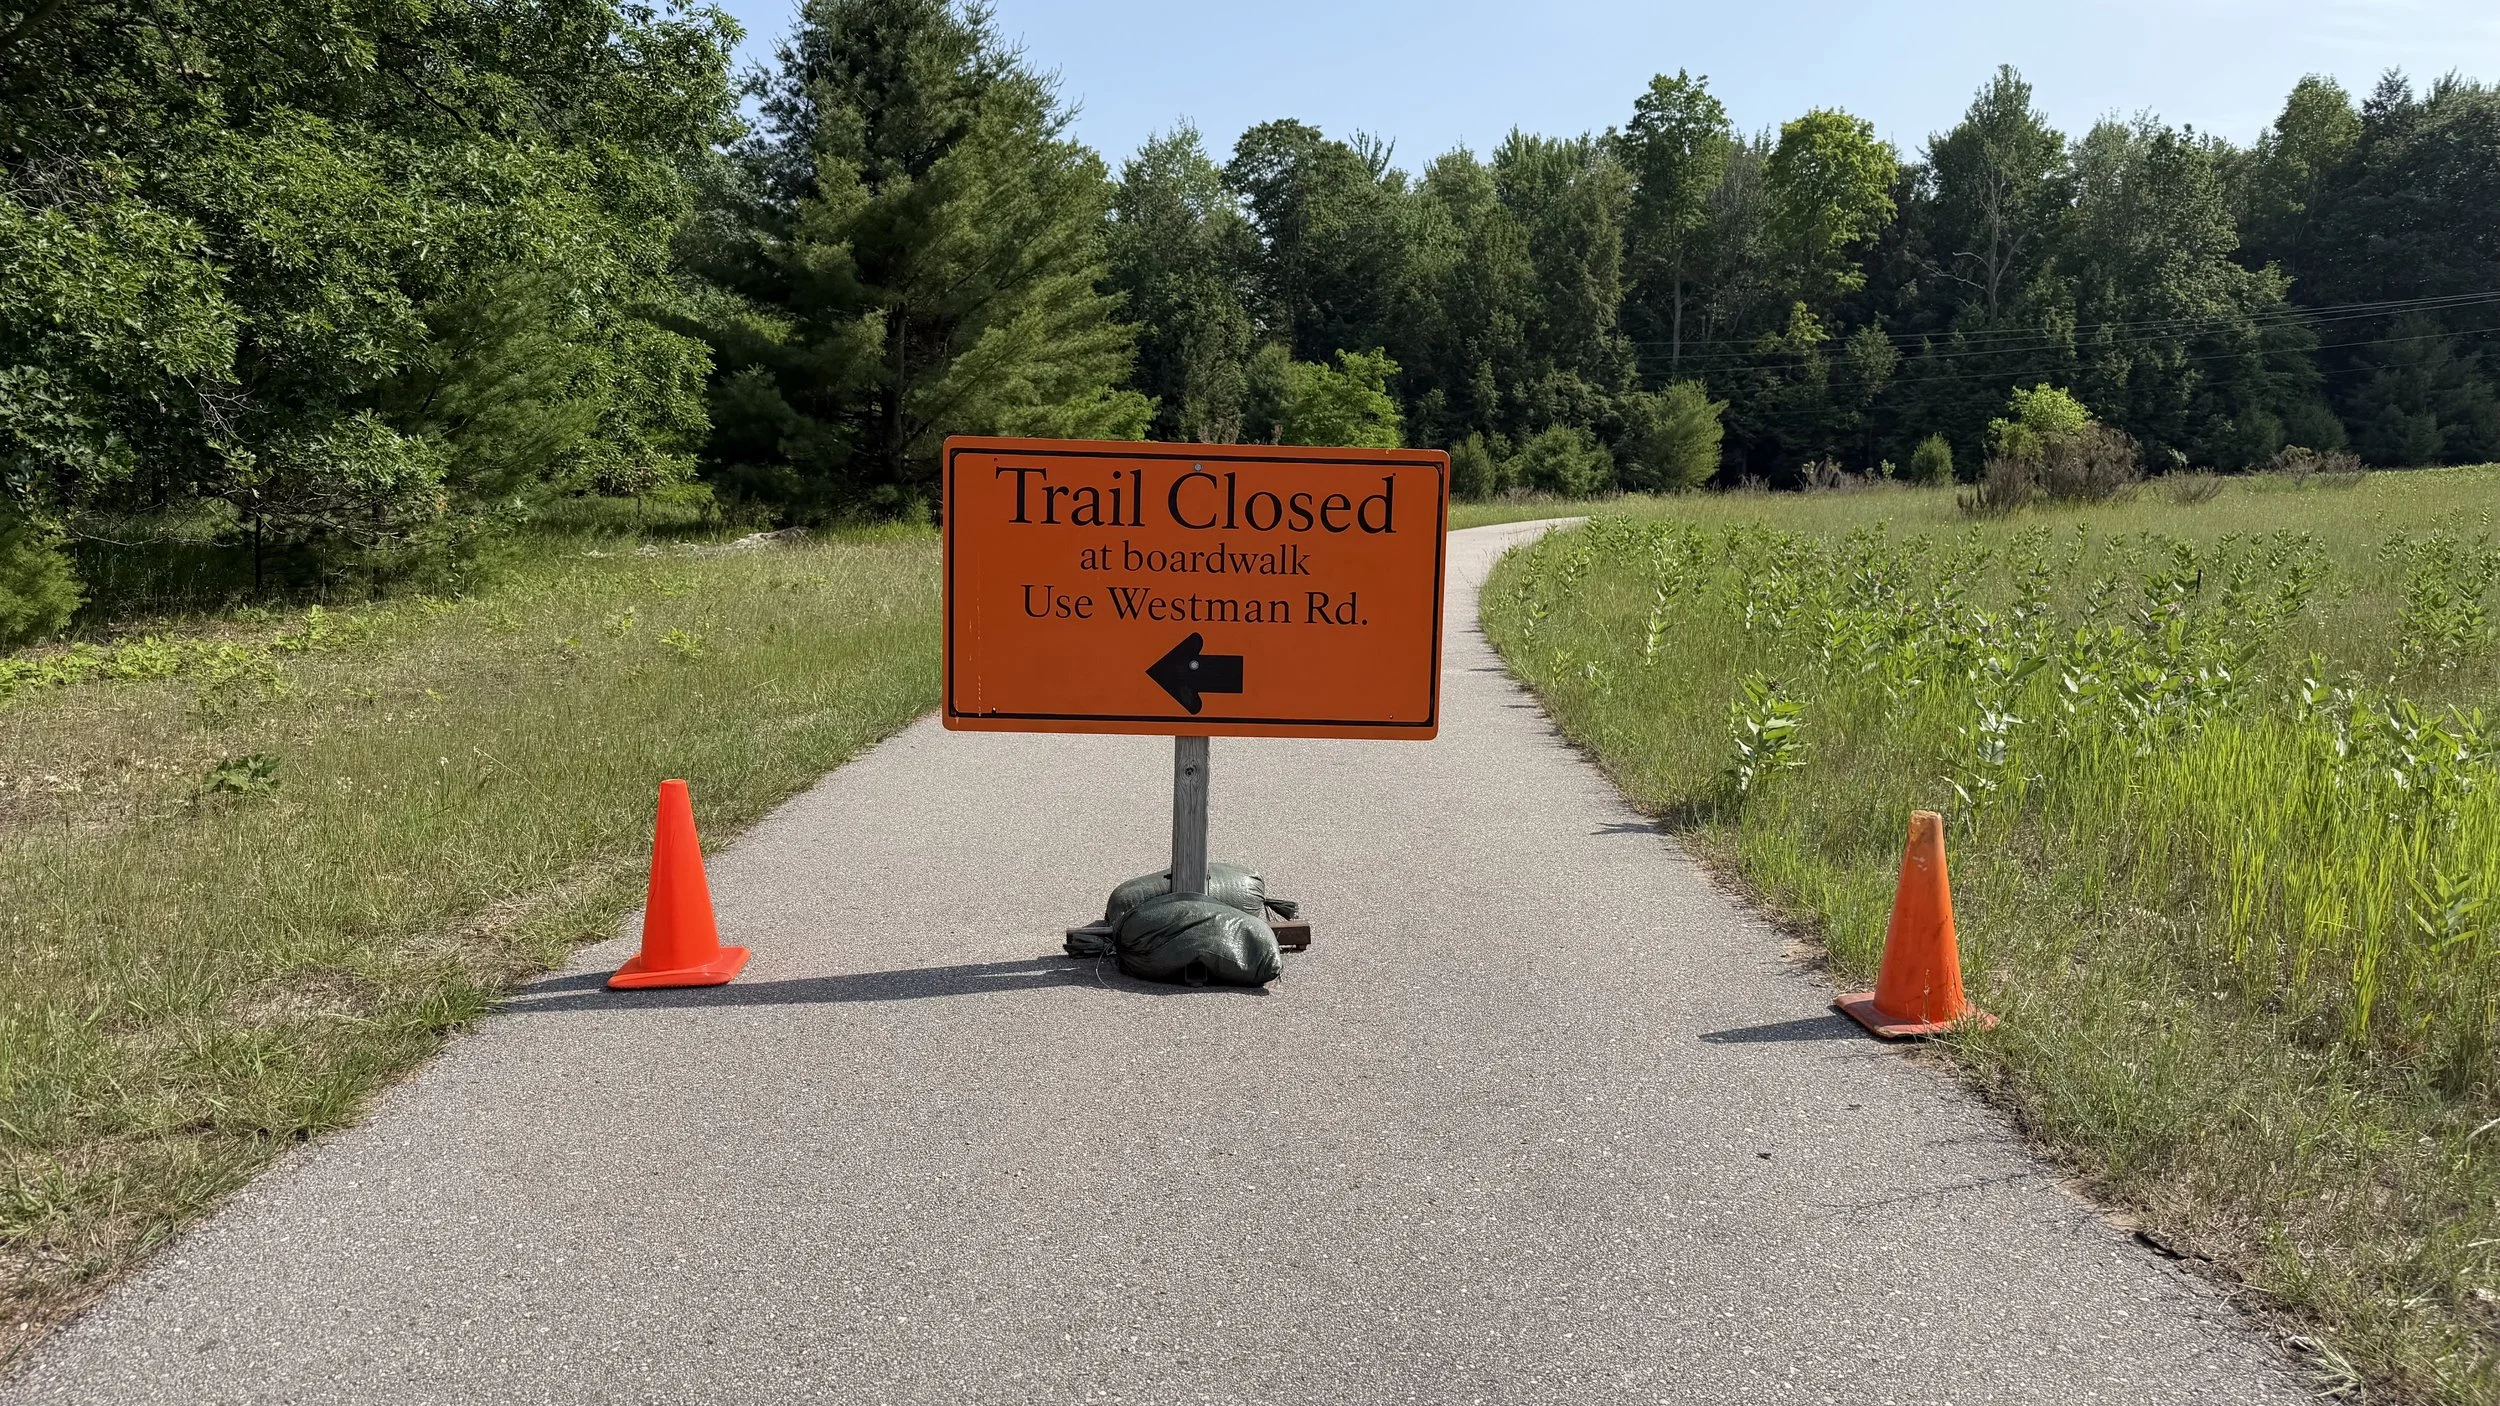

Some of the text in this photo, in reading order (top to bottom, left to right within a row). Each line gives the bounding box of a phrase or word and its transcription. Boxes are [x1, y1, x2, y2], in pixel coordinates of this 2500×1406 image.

[995, 466, 1397, 534] Trail Closed
[1080, 539, 1311, 576] at boardwalk
[1021, 584, 1369, 626] Use Westman Rd.
